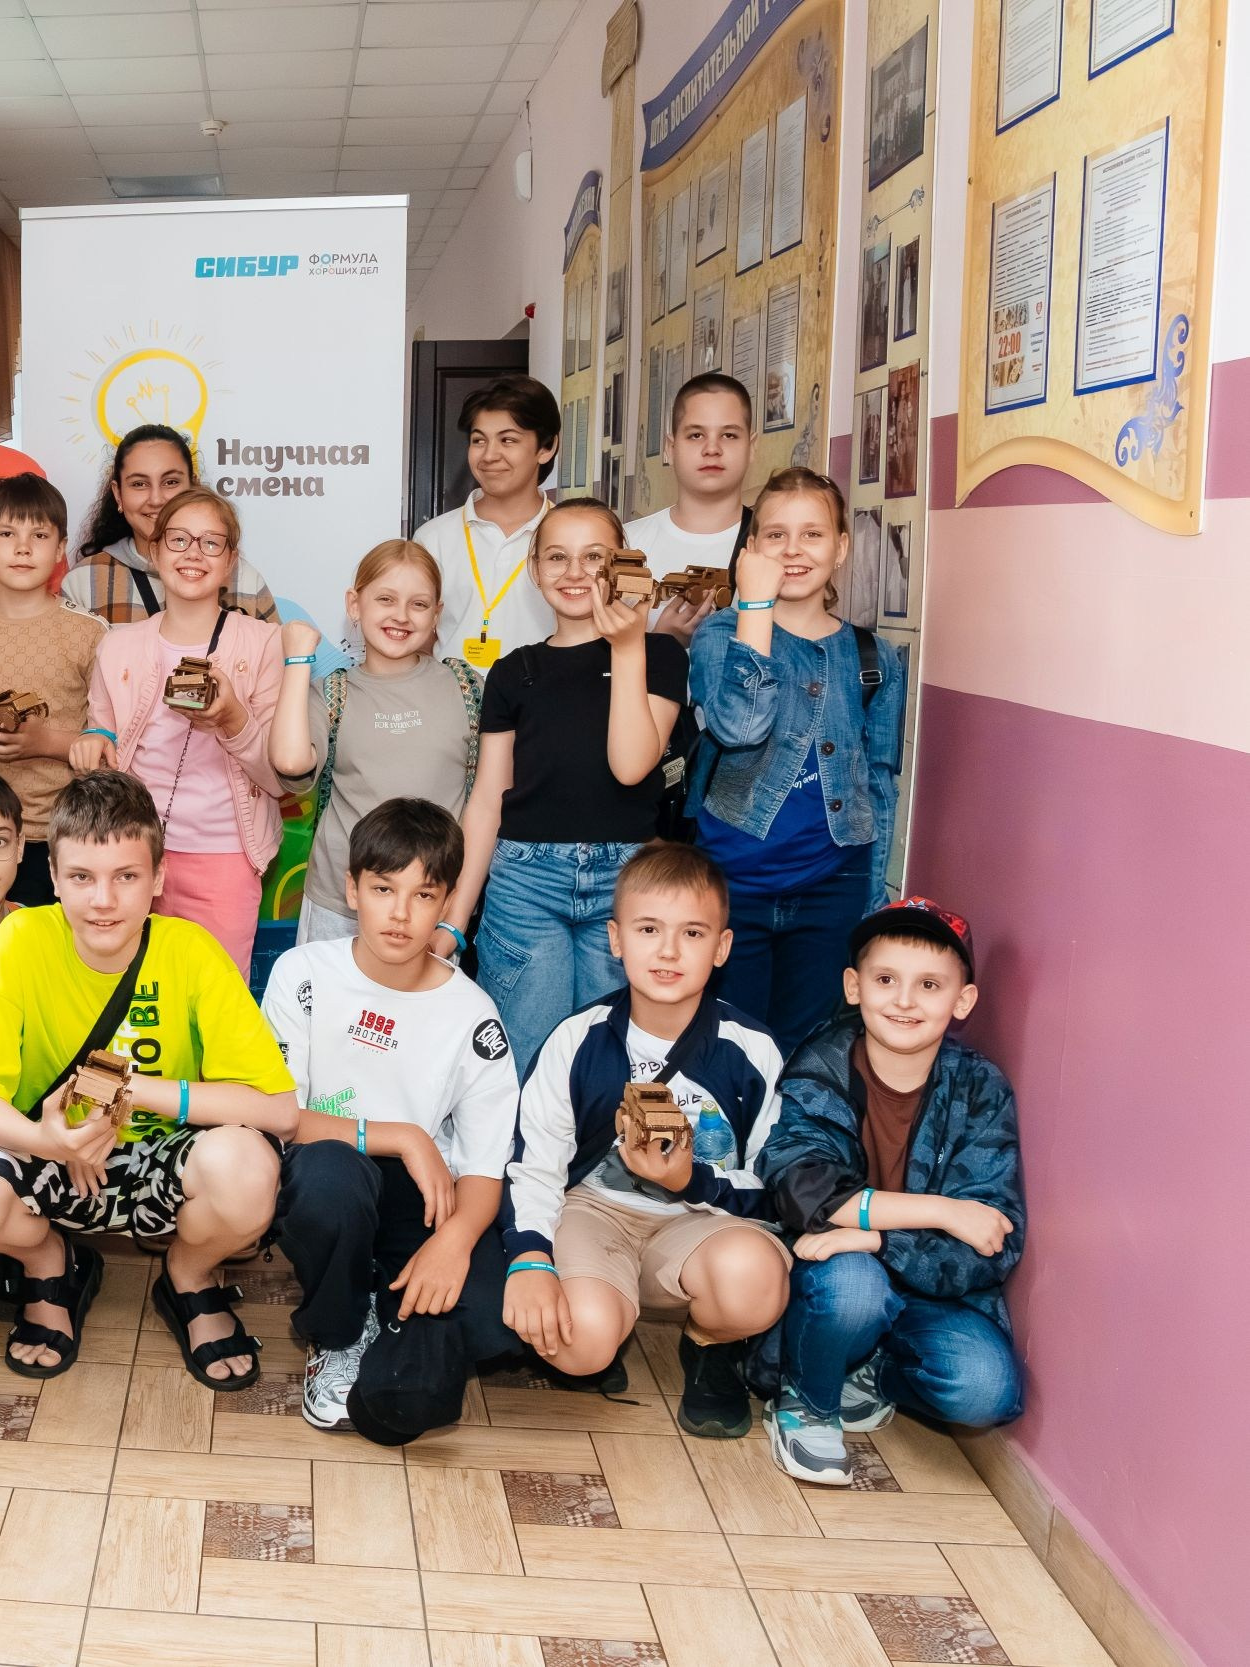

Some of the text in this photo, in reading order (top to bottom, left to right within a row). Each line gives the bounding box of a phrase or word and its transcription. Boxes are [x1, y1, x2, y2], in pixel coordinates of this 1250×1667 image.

[195, 253, 378, 278] СИБУР ФОРМУЛА
[309, 266, 379, 276] ХОРОШИХ ДЕЛ
[998, 332, 1021, 357] 22:00
[216, 438, 370, 473] Научная
[216, 476, 325, 497] смена
[130, 982, 160, 1026] BE
[359, 1010, 396, 1036] 1992
[347, 1025, 398, 1049] BROTHER
